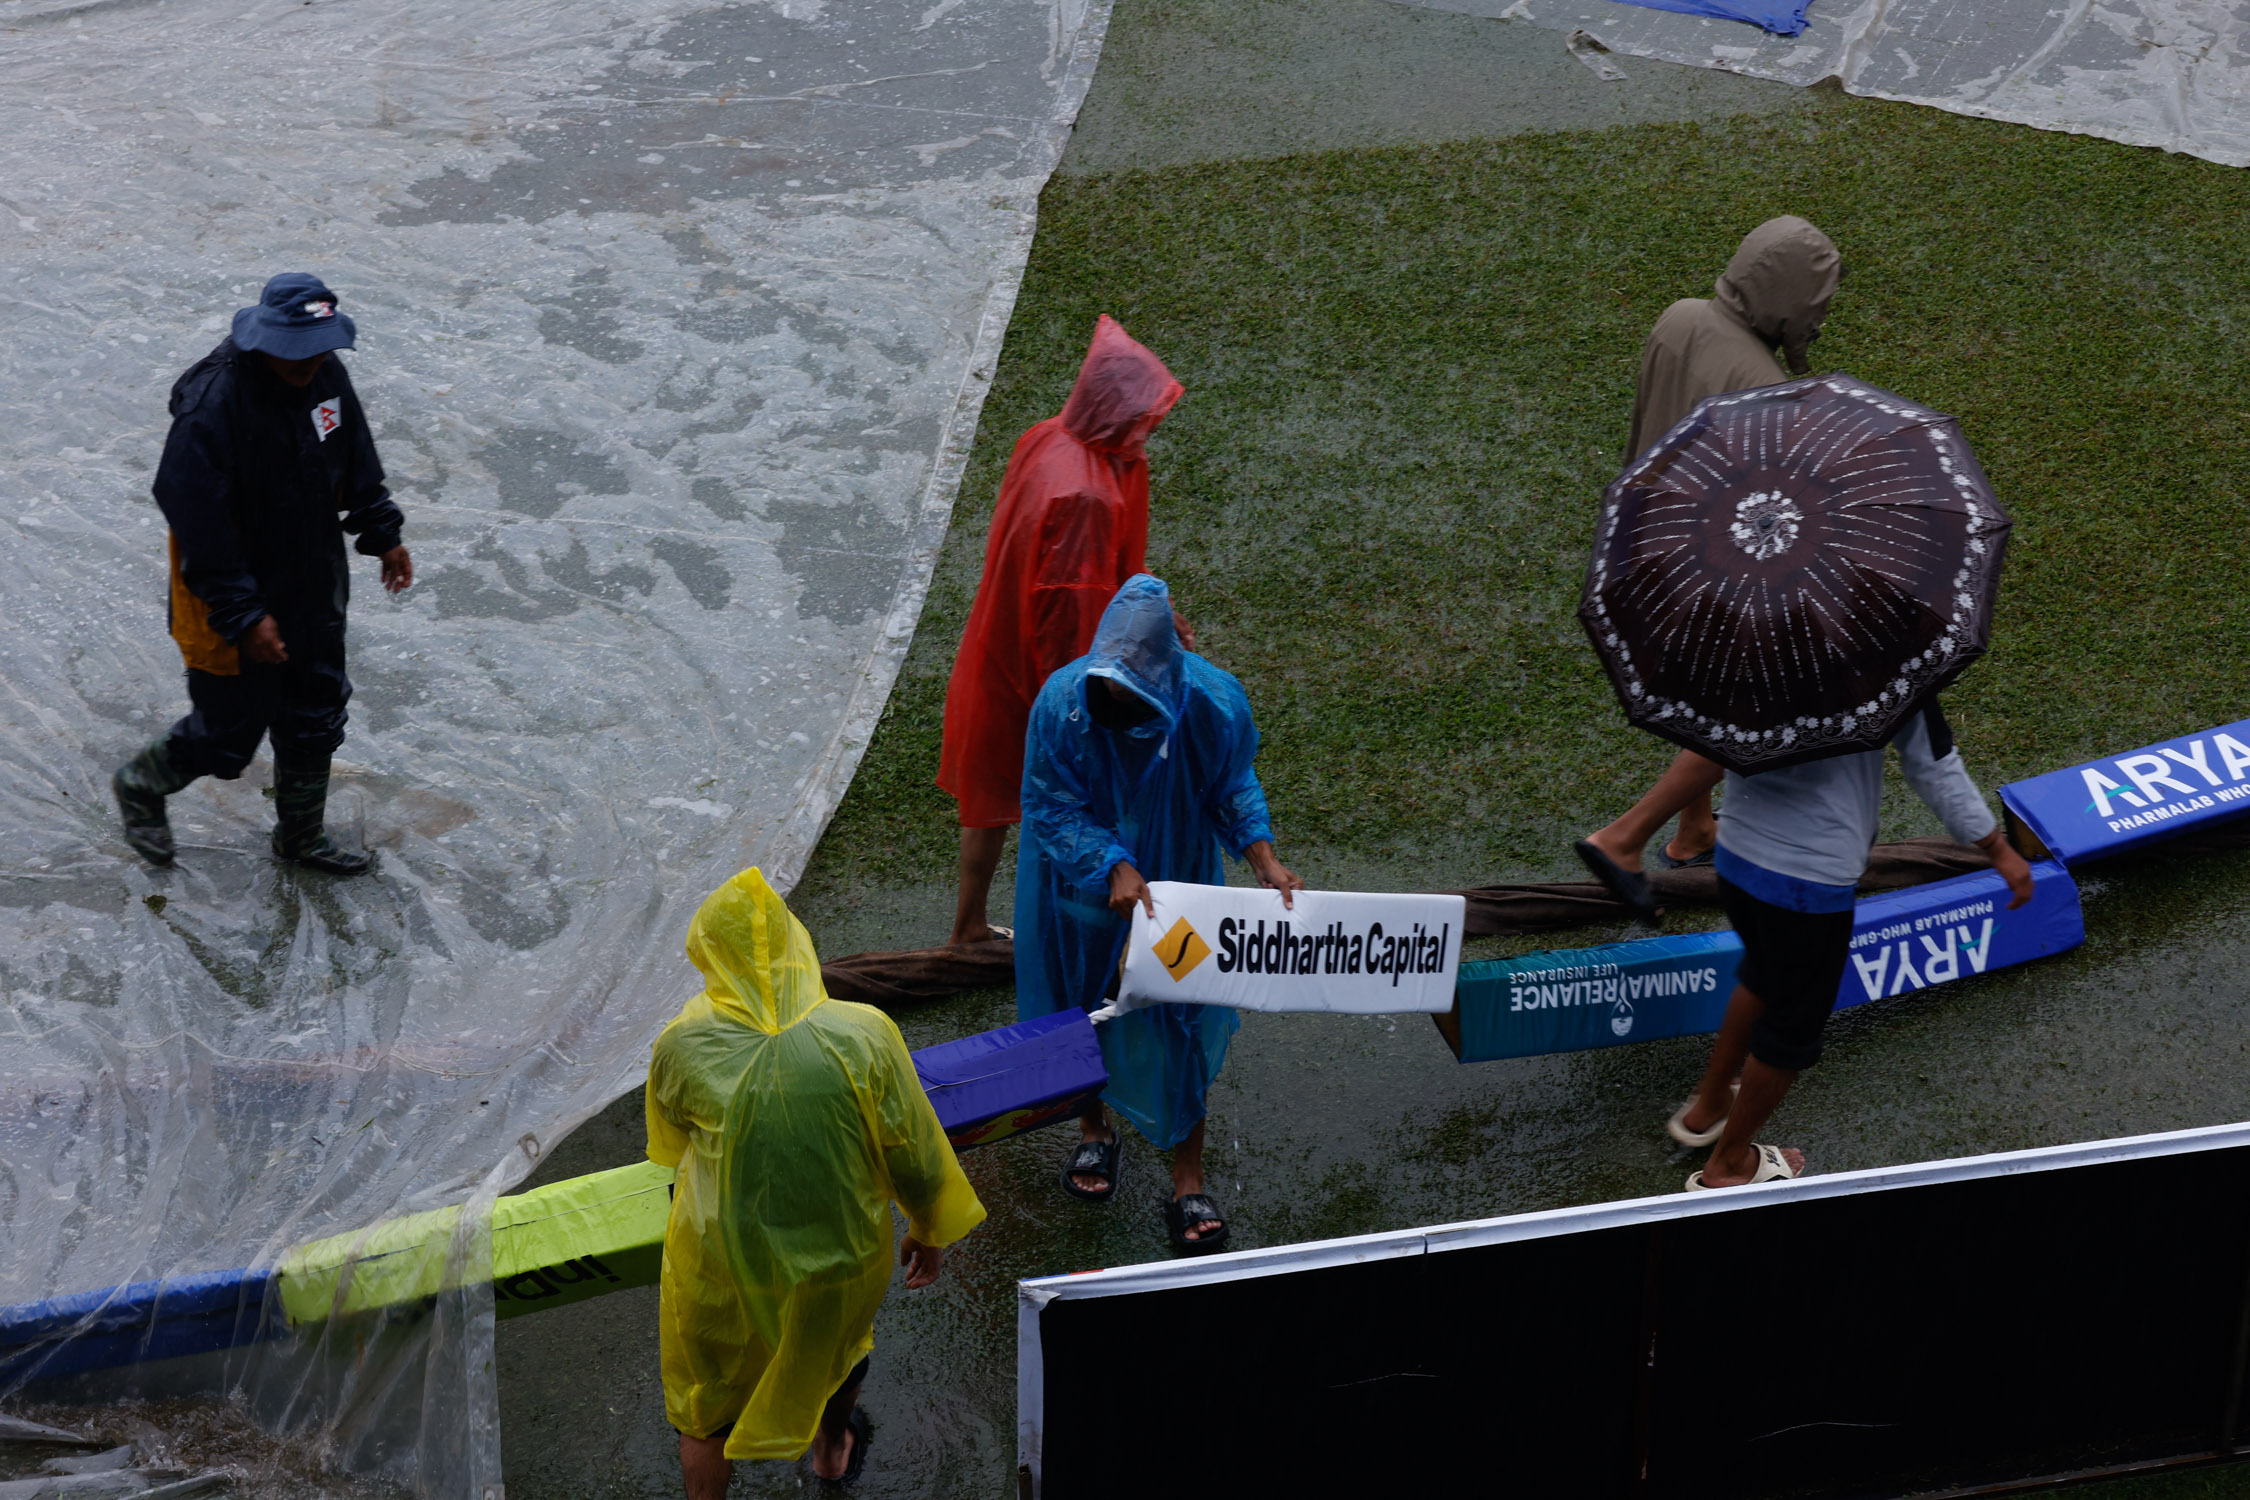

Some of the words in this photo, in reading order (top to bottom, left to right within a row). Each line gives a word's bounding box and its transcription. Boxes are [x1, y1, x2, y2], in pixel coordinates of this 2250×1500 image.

[2080, 733, 2250, 817] ARYA
[2108, 795, 2215, 832] PHARMALAB
[1914, 900, 1993, 931] PHARMALAB
[1849, 922, 1912, 949] WHO-GMP
[1508, 965, 1588, 984] INSURANCE
[1592, 962, 1619, 973] LIFE
[1851, 917, 1994, 1001] ARYA
[1510, 978, 1618, 1011] RELIANCE
[1628, 967, 1717, 999] SANIMA
